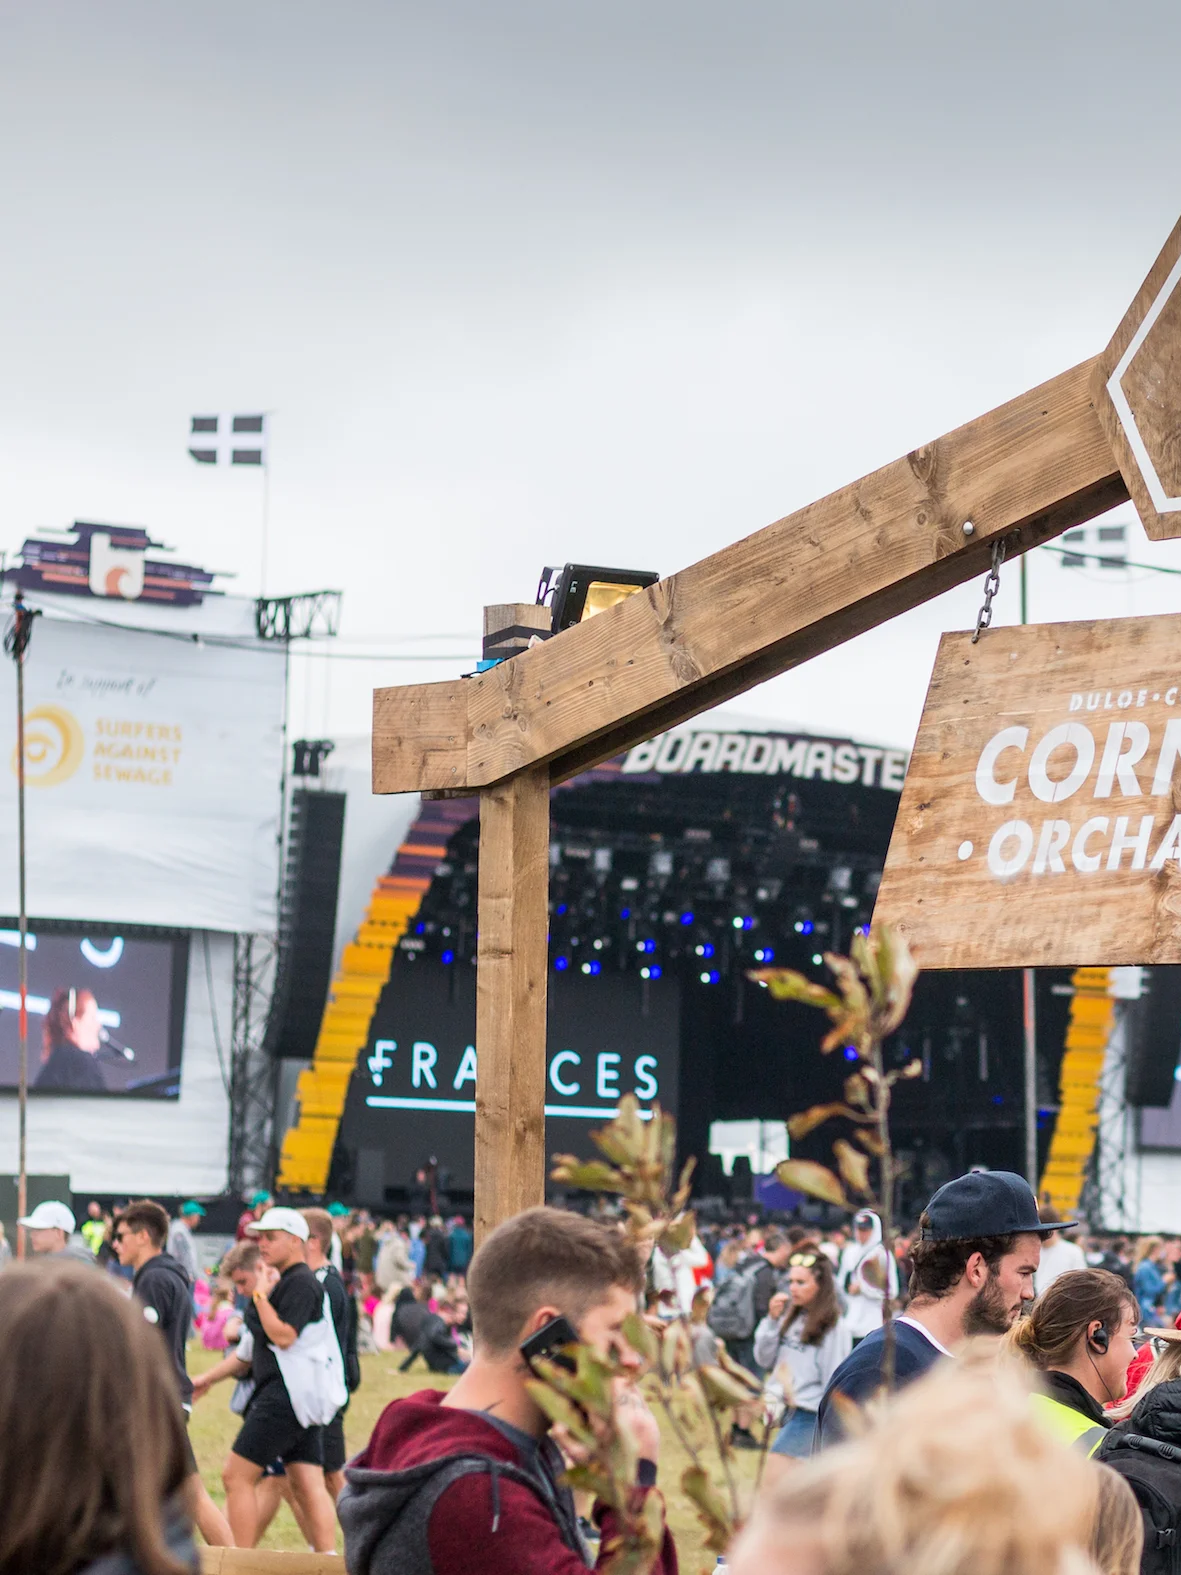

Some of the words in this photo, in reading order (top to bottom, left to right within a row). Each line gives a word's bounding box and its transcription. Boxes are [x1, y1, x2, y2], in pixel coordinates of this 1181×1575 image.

[94, 718, 183, 742] SURFERS
[92, 741, 182, 765] AGAINST
[621, 731, 909, 792] BOARDMASTE
[93, 763, 173, 786] SEWAGE
[368, 1039, 659, 1100] FRACES
